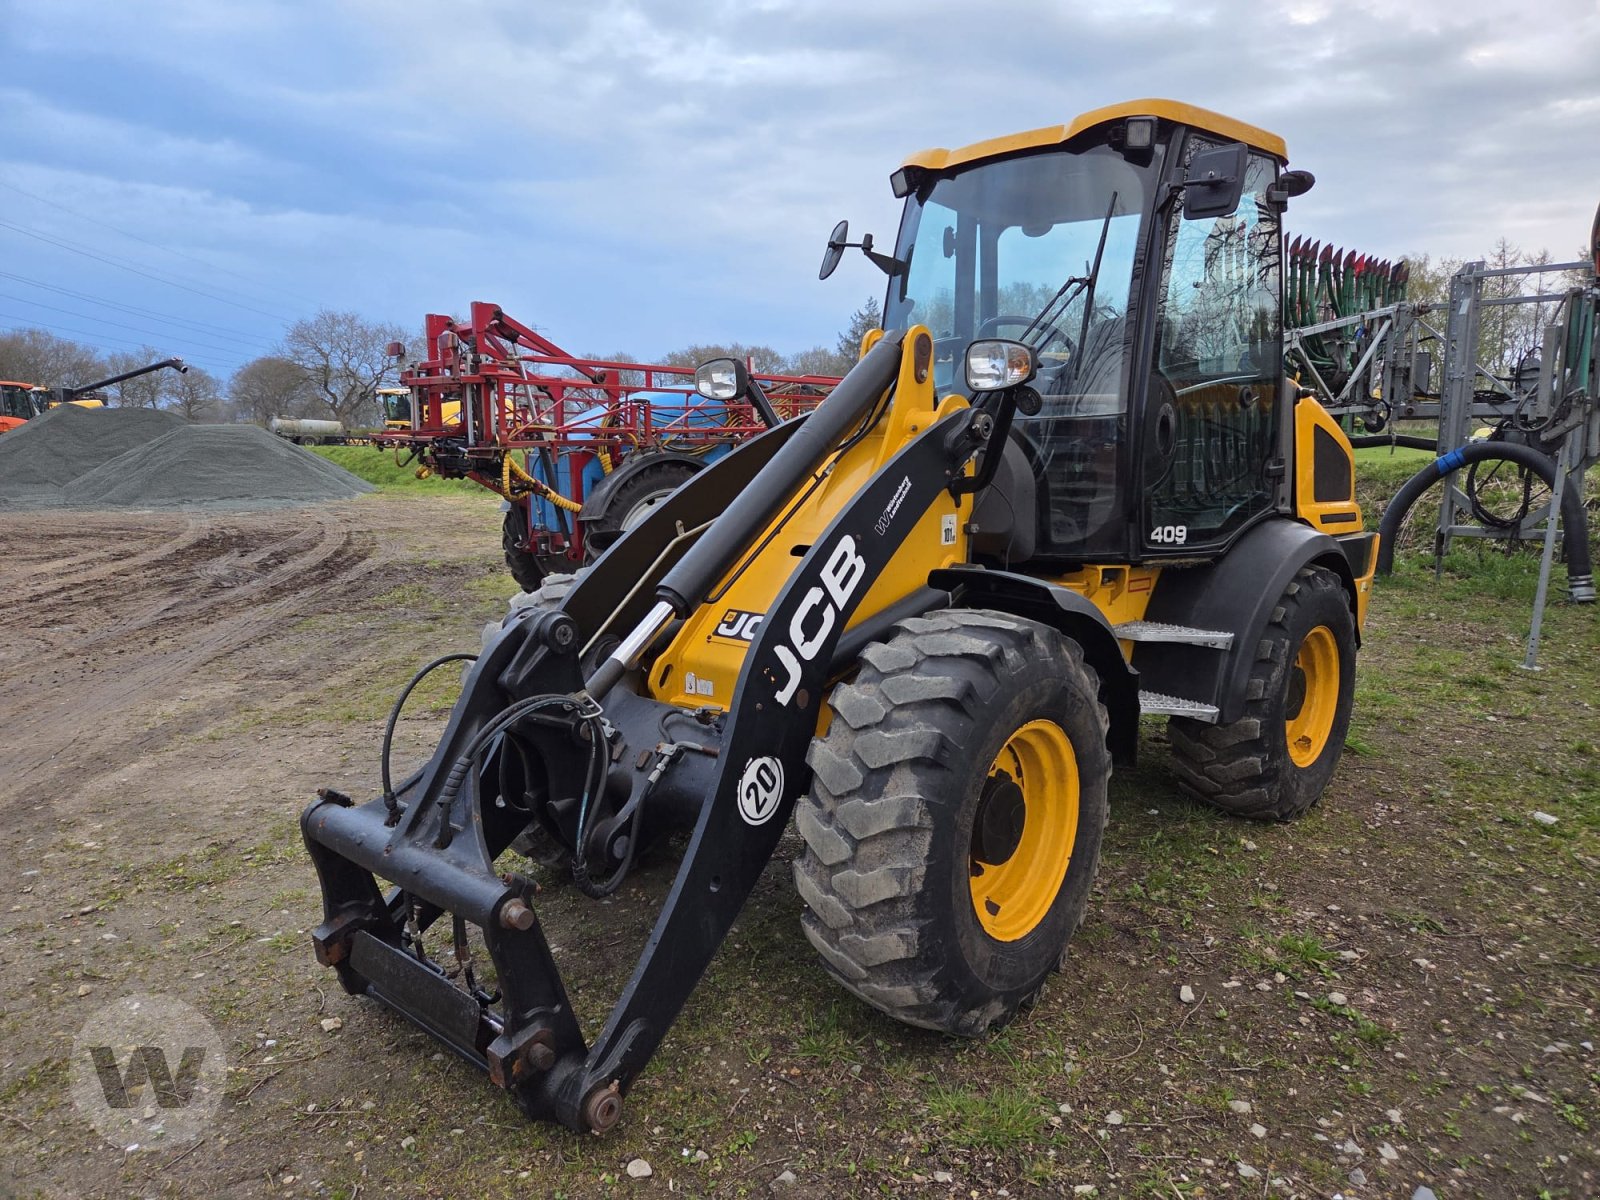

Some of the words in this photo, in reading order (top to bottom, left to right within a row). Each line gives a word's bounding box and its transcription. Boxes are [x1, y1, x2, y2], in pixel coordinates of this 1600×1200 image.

[1150, 525, 1187, 543] 409
[717, 613, 765, 640] JC
[773, 534, 866, 707] JCB
[746, 762, 776, 815] 20
